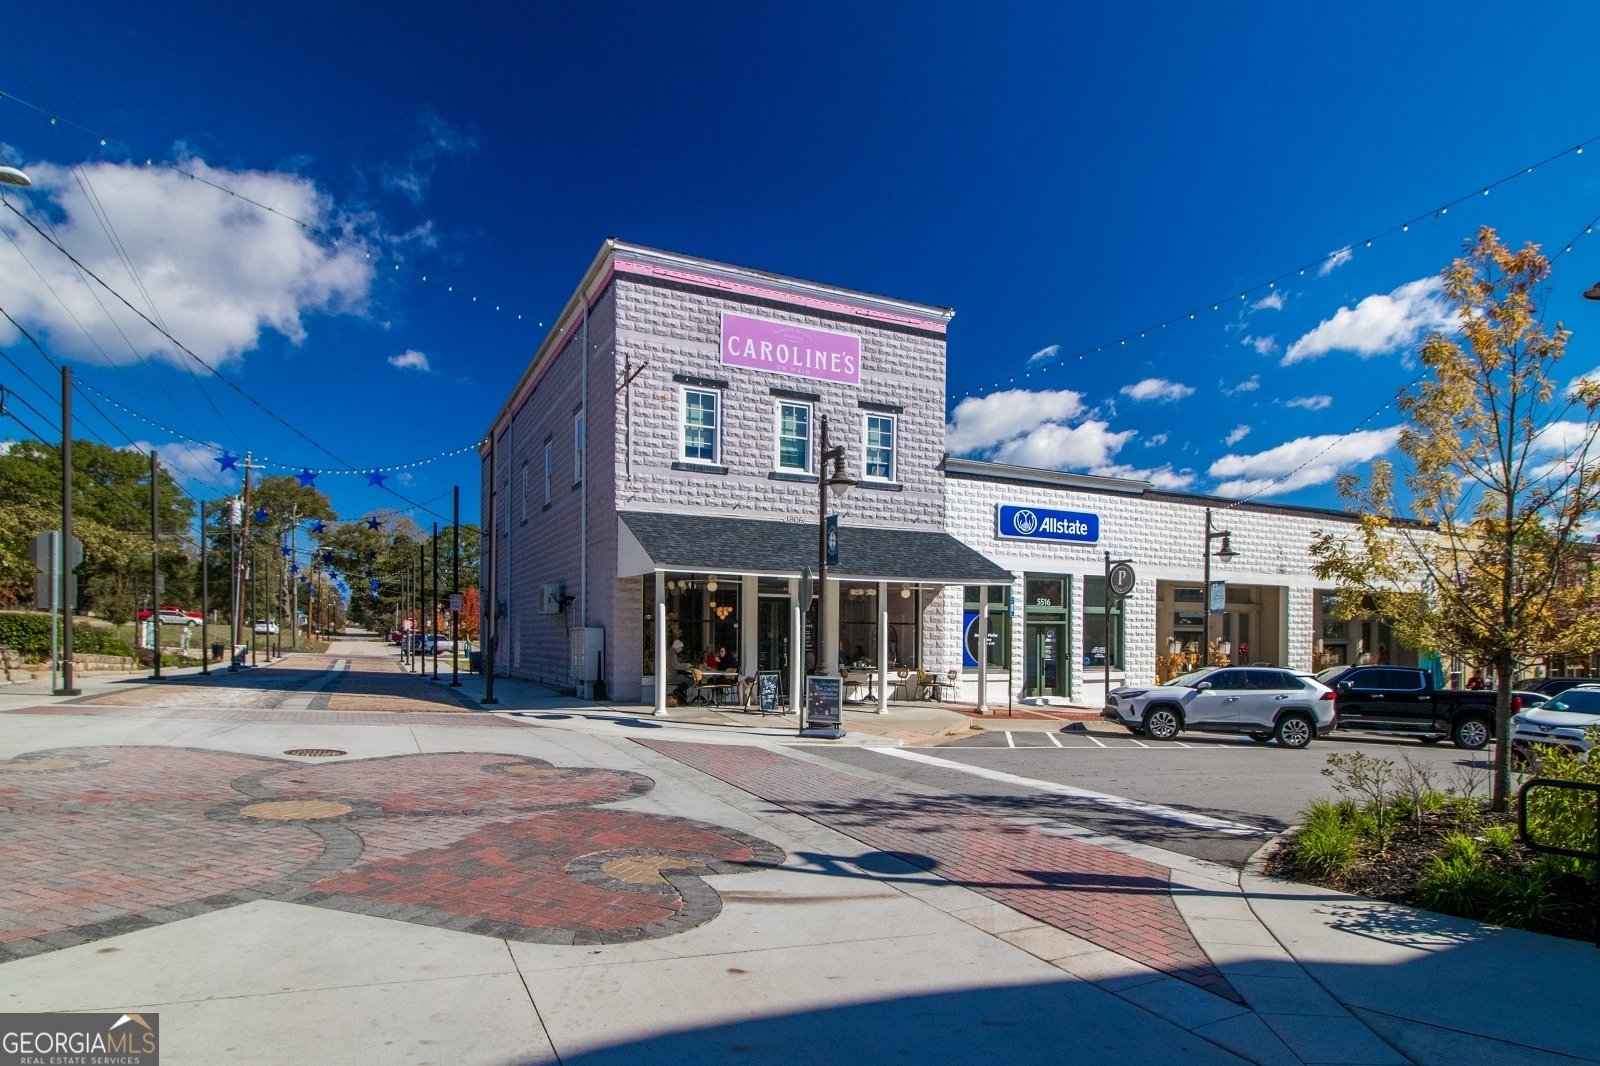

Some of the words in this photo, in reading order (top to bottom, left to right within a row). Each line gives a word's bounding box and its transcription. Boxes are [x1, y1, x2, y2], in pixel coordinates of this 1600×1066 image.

[728, 336, 855, 374] CAROLINE'S
[791, 366, 810, 374] MAIN
[1038, 517, 1088, 536] Allstate
[1118, 570, 1127, 585] P
[1036, 598, 1051, 606] 5516
